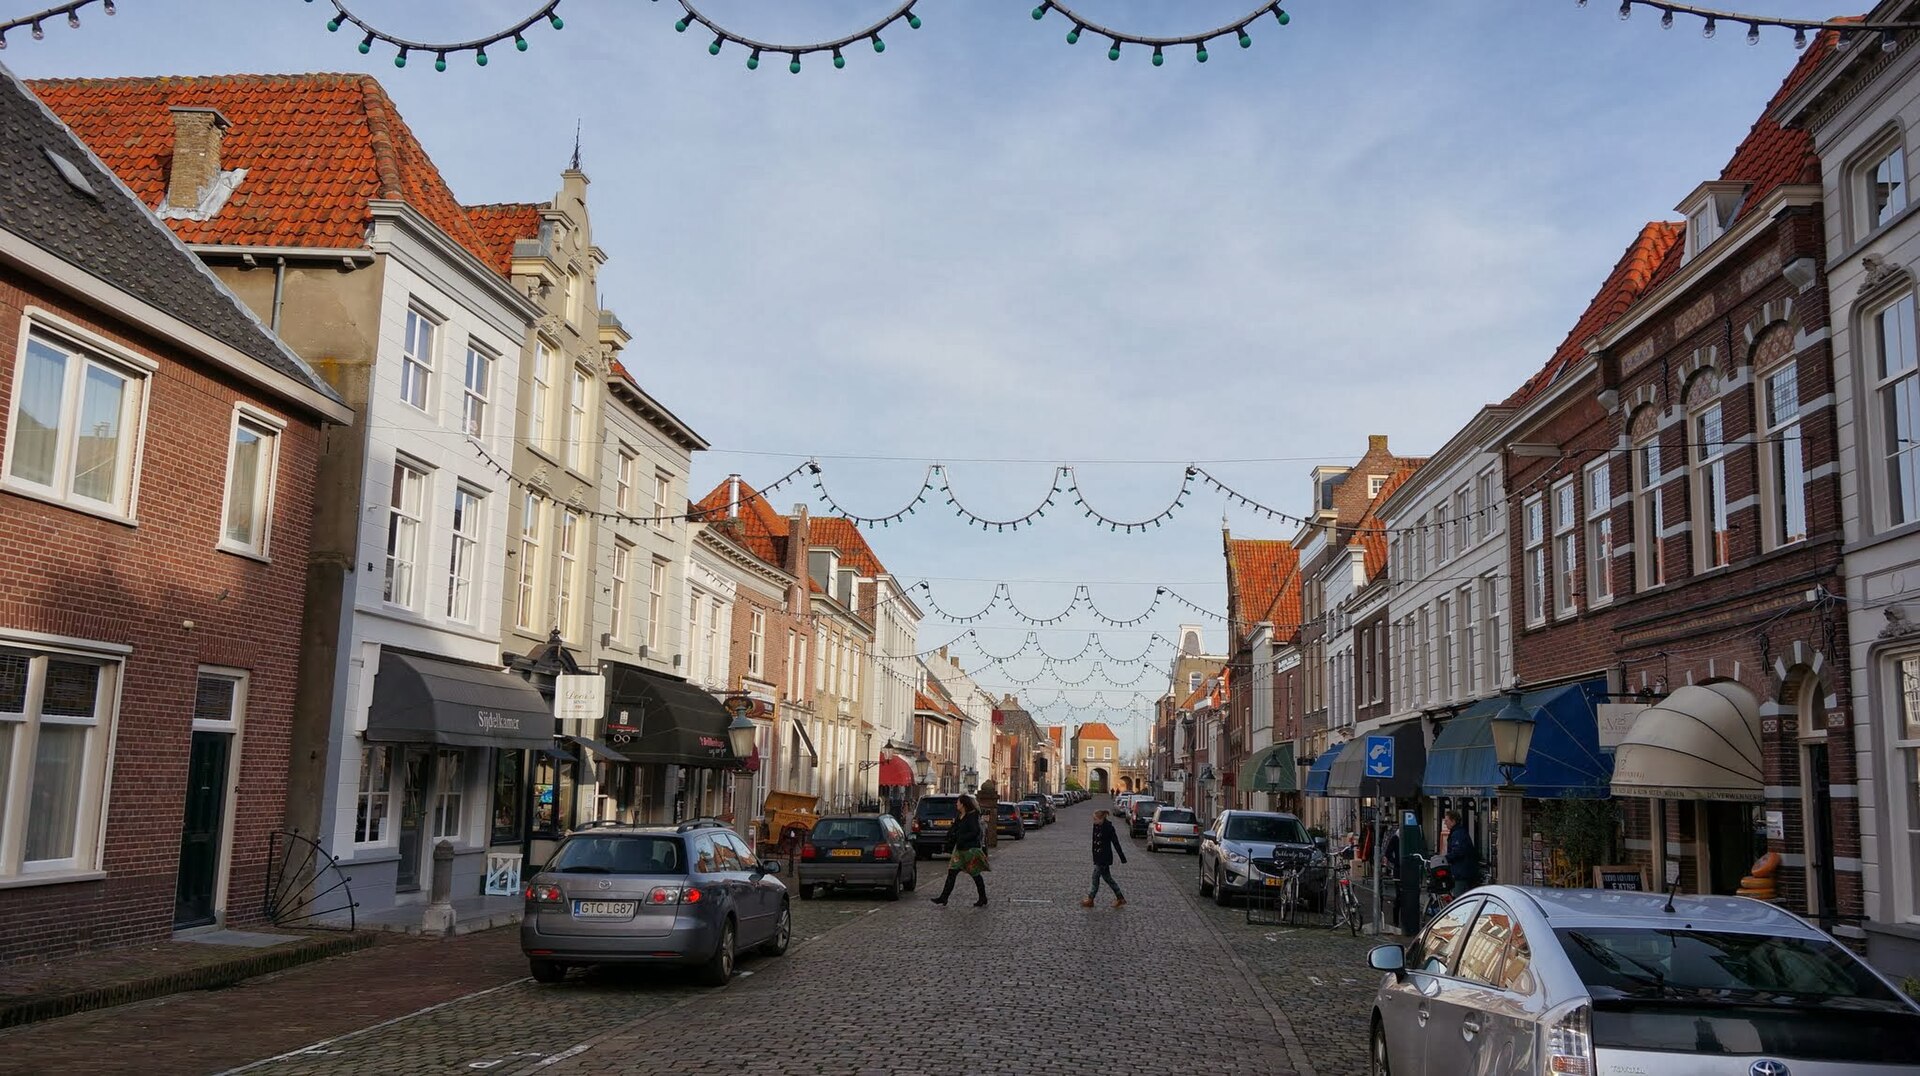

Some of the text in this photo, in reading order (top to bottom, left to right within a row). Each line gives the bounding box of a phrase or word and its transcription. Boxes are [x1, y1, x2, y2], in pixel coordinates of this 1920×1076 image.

[478, 711, 520, 732] Sijdelkamer
[1405, 812, 1414, 825] P
[582, 903, 633, 914] GTC LG87
